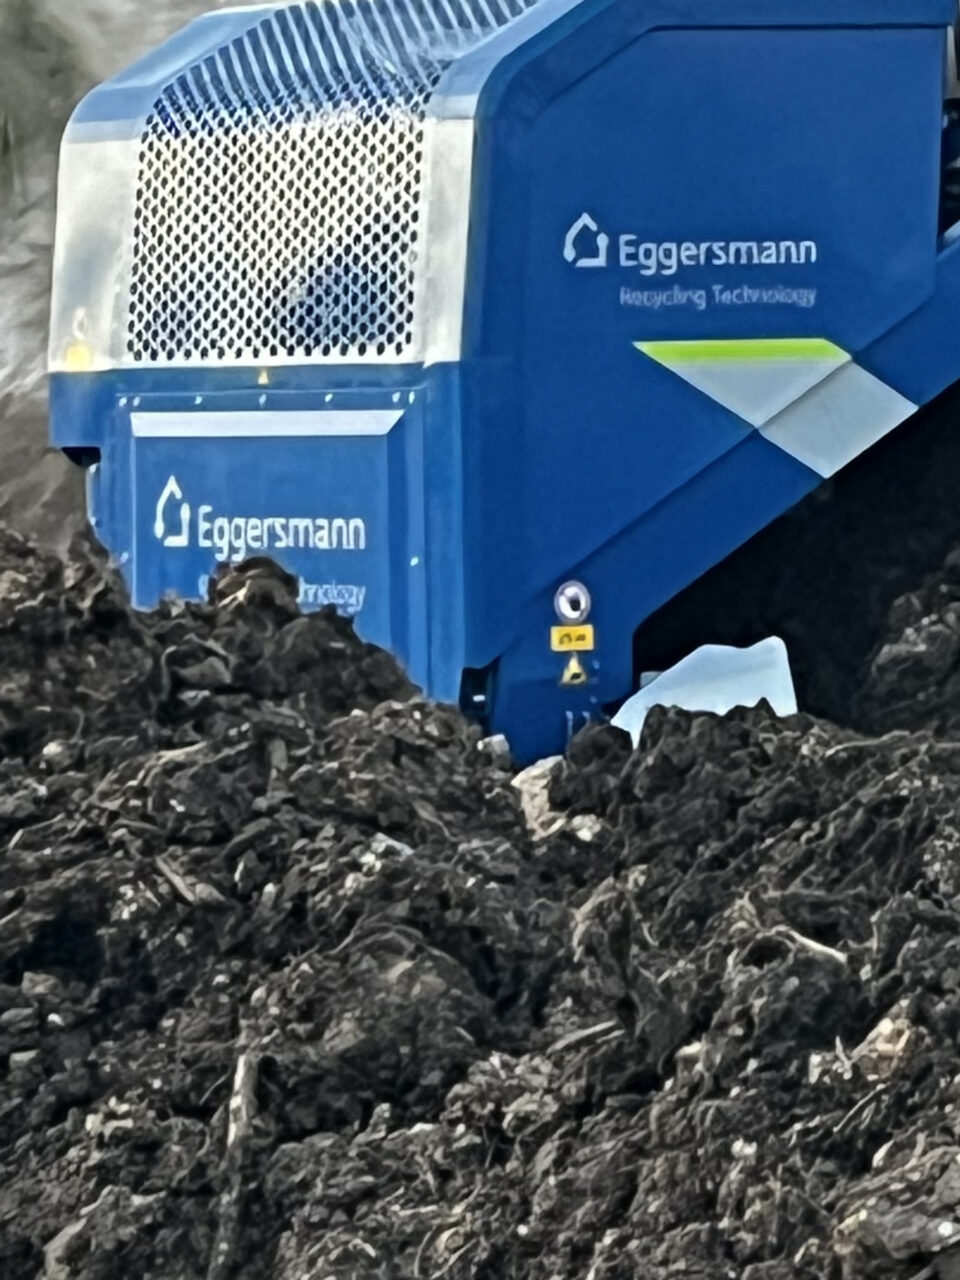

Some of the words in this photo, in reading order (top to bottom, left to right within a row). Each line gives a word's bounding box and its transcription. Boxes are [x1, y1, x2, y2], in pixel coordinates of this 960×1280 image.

[618, 233, 817, 276] Eggersmann
[619, 286, 706, 310] Recycling
[711, 284, 817, 308] Technology
[198, 505, 366, 562] Eggersmann
